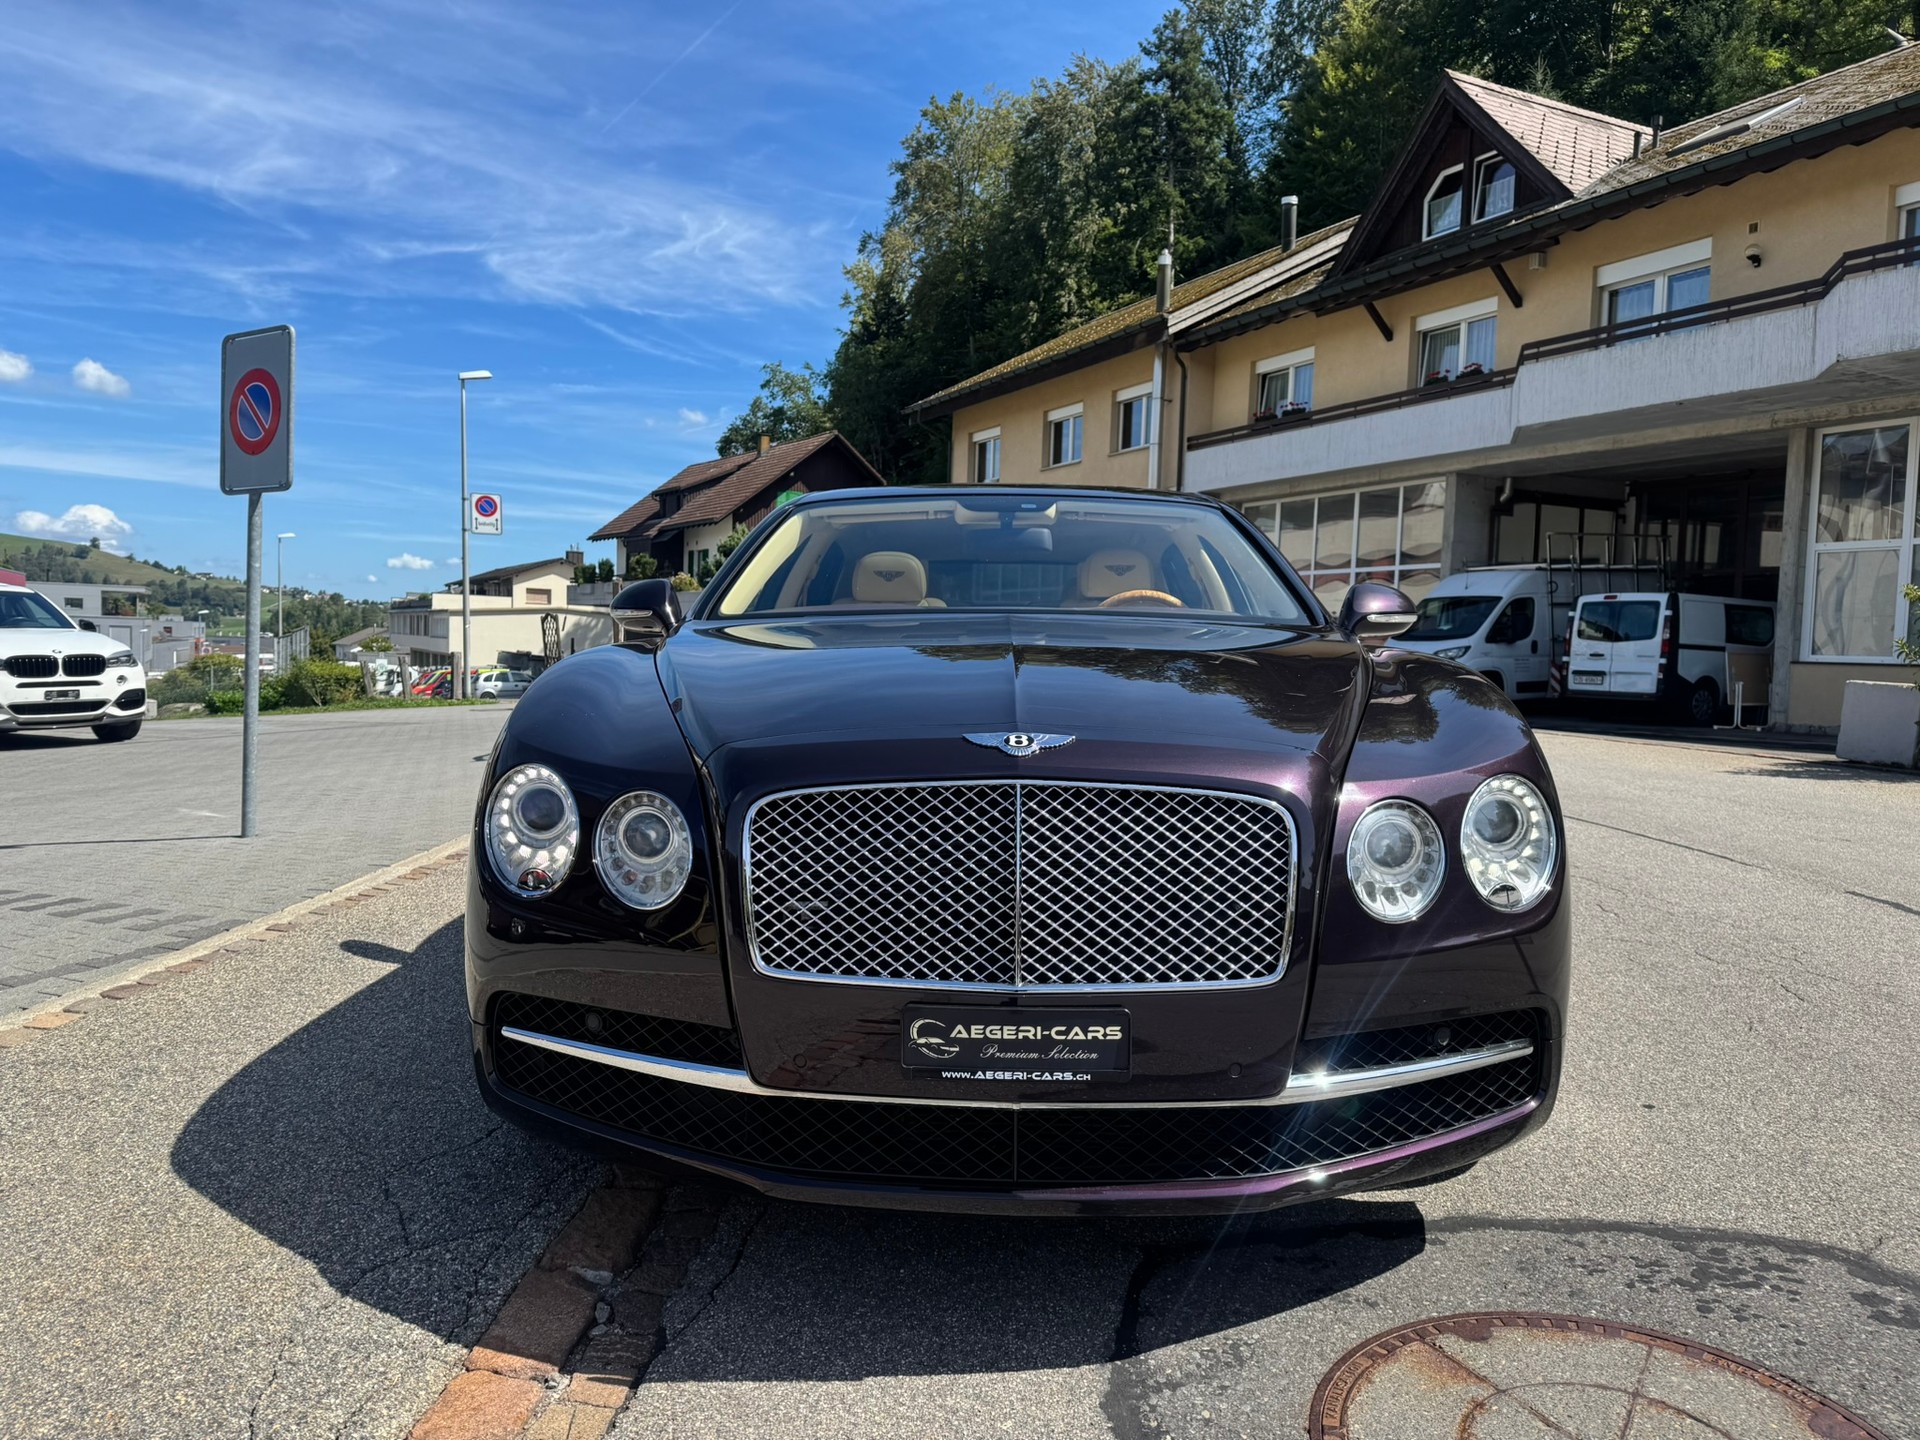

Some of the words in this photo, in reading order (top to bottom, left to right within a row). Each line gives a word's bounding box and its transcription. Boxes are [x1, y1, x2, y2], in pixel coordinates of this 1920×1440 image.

[1008, 734, 1029, 747] B
[950, 1024, 1123, 1040] AEGERI-CARS
[979, 1043, 1039, 1059] Premium
[1041, 1044, 1100, 1060] Selection
